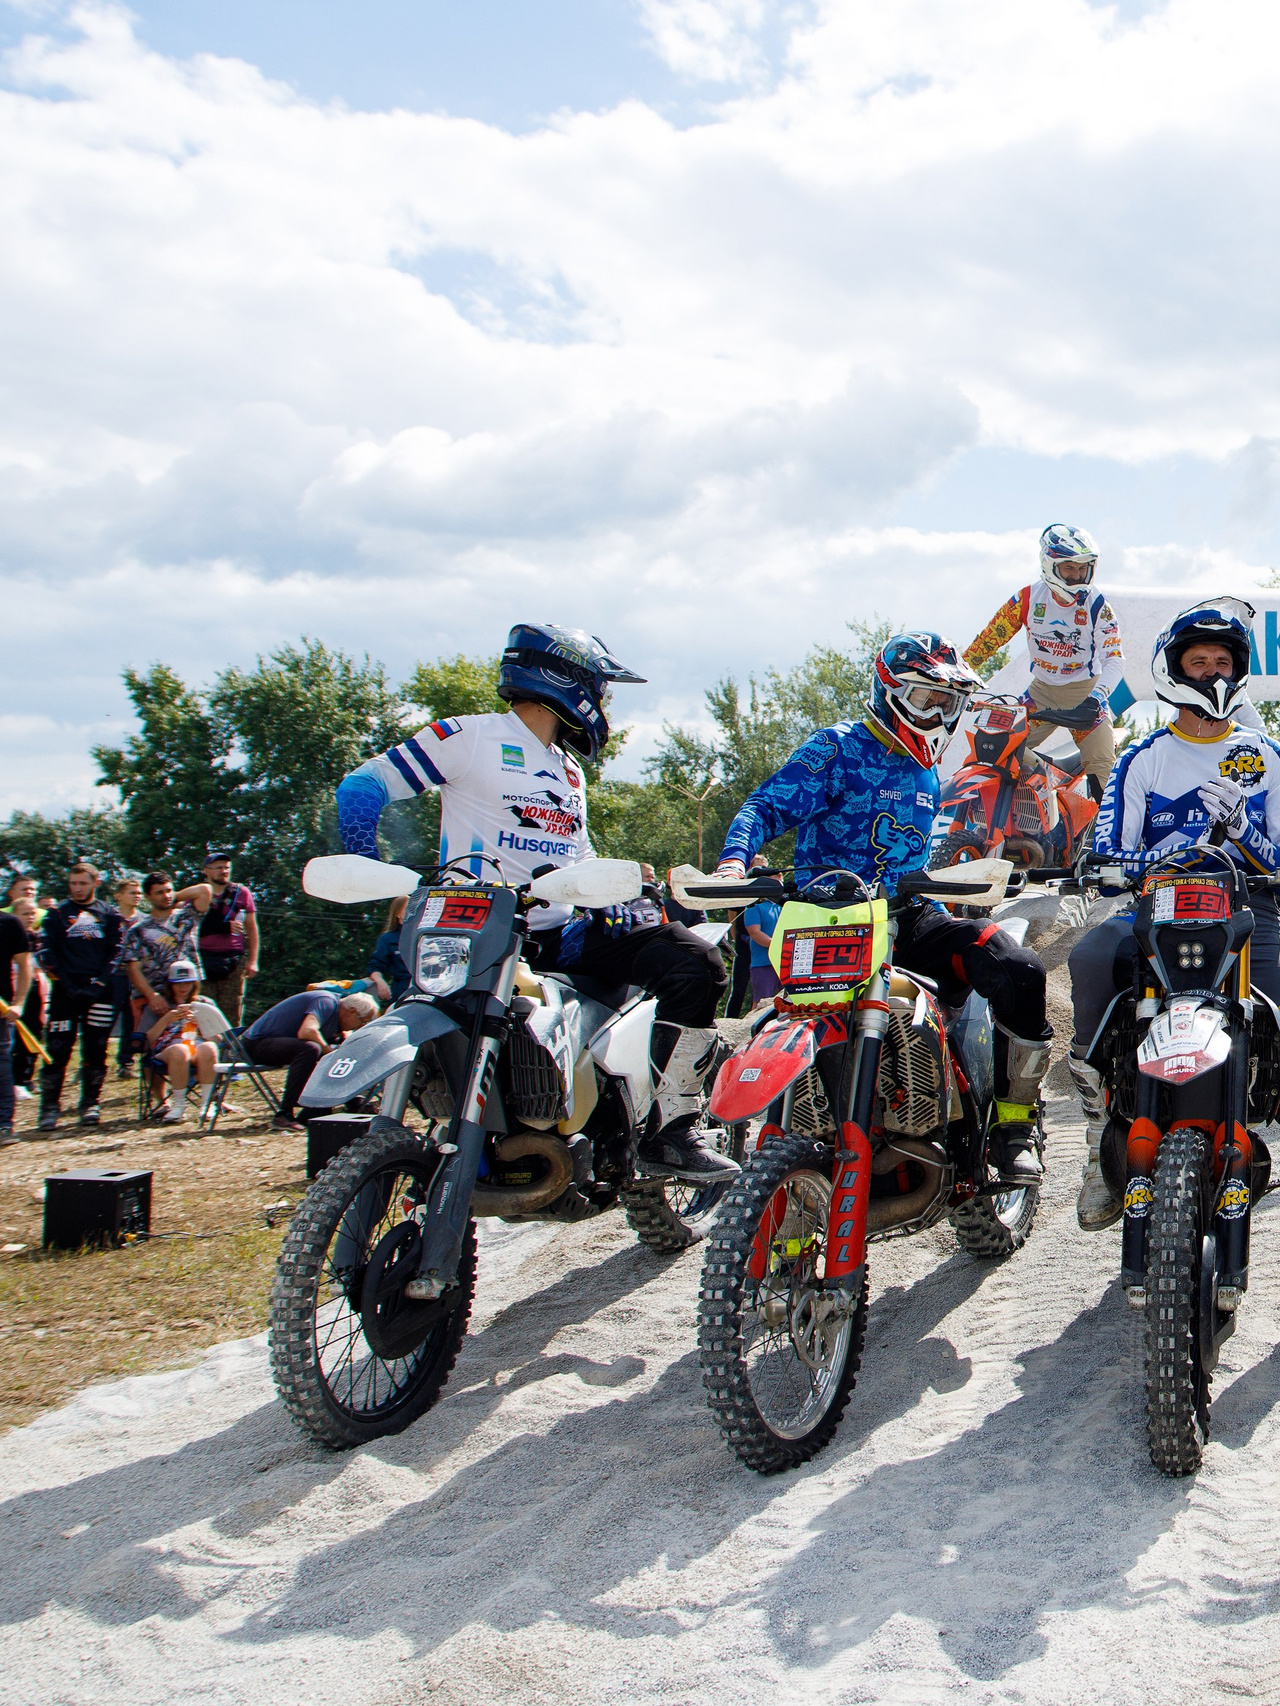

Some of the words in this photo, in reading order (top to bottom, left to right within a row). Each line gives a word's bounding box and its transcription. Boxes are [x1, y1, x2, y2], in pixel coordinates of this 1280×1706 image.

[1039, 638, 1073, 651] ЮЖНЫЙ
[1052, 649, 1073, 658] УРАЛ
[502, 793, 554, 807] МОТОСПОРТ
[879, 789, 902, 801] SHVED
[521, 805, 576, 826] ЮЖНЫЙ
[497, 830, 578, 857] Husqvar
[1205, 879, 1218, 887] 2024
[1176, 893, 1221, 912] 29
[441, 904, 486, 924] 24
[844, 930, 857, 938] 2024
[814, 945, 860, 965] 34
[49, 1020, 71, 1033] FH
[1163, 1068, 1196, 1077] ENDURO
[436, 1181, 449, 1215] Husqvarna
[836, 1171, 859, 1263] URAL
